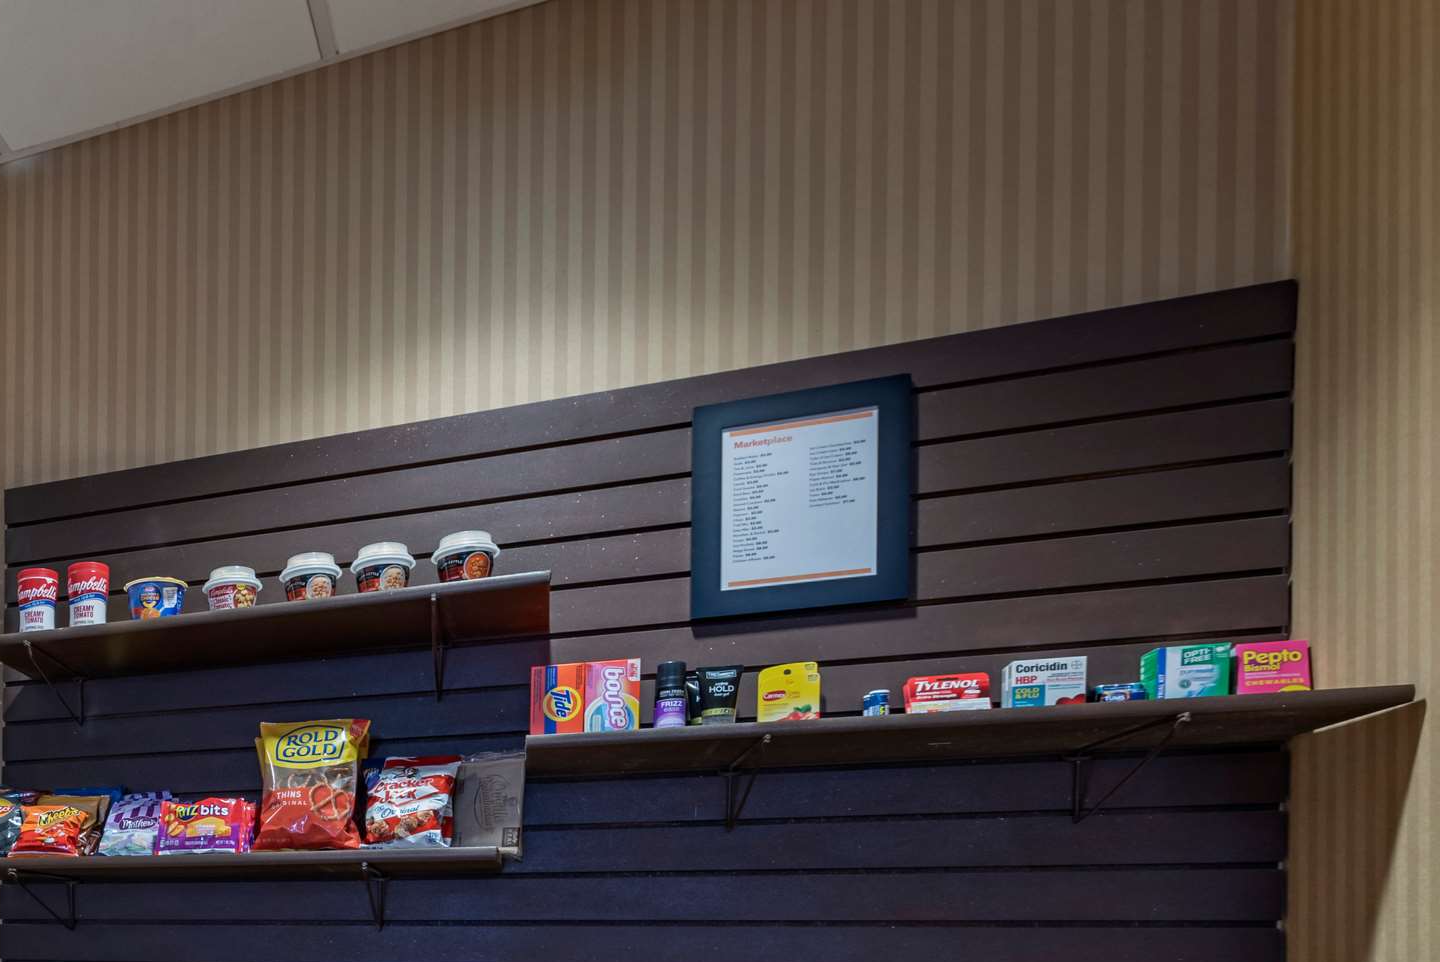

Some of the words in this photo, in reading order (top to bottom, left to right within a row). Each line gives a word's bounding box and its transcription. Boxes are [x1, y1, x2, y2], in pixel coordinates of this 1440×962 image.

[734, 436, 793, 449] Marketplace
[24, 610, 45, 618] CREAMY
[74, 605, 95, 613] CREAMY
[1243, 649, 1303, 666] Pepto
[1016, 662, 1068, 674] Coricidin
[915, 679, 980, 693] TYLENOL
[1016, 675, 1037, 684] HBP
[708, 685, 735, 693] HOLD
[550, 689, 572, 718] Tide
[660, 700, 683, 708] FRIZZ
[286, 730, 339, 746] ROLD
[282, 743, 338, 758] GOLD
[374, 777, 434, 794] Cracker
[276, 791, 302, 800] THINS
[200, 803, 229, 816] bits
